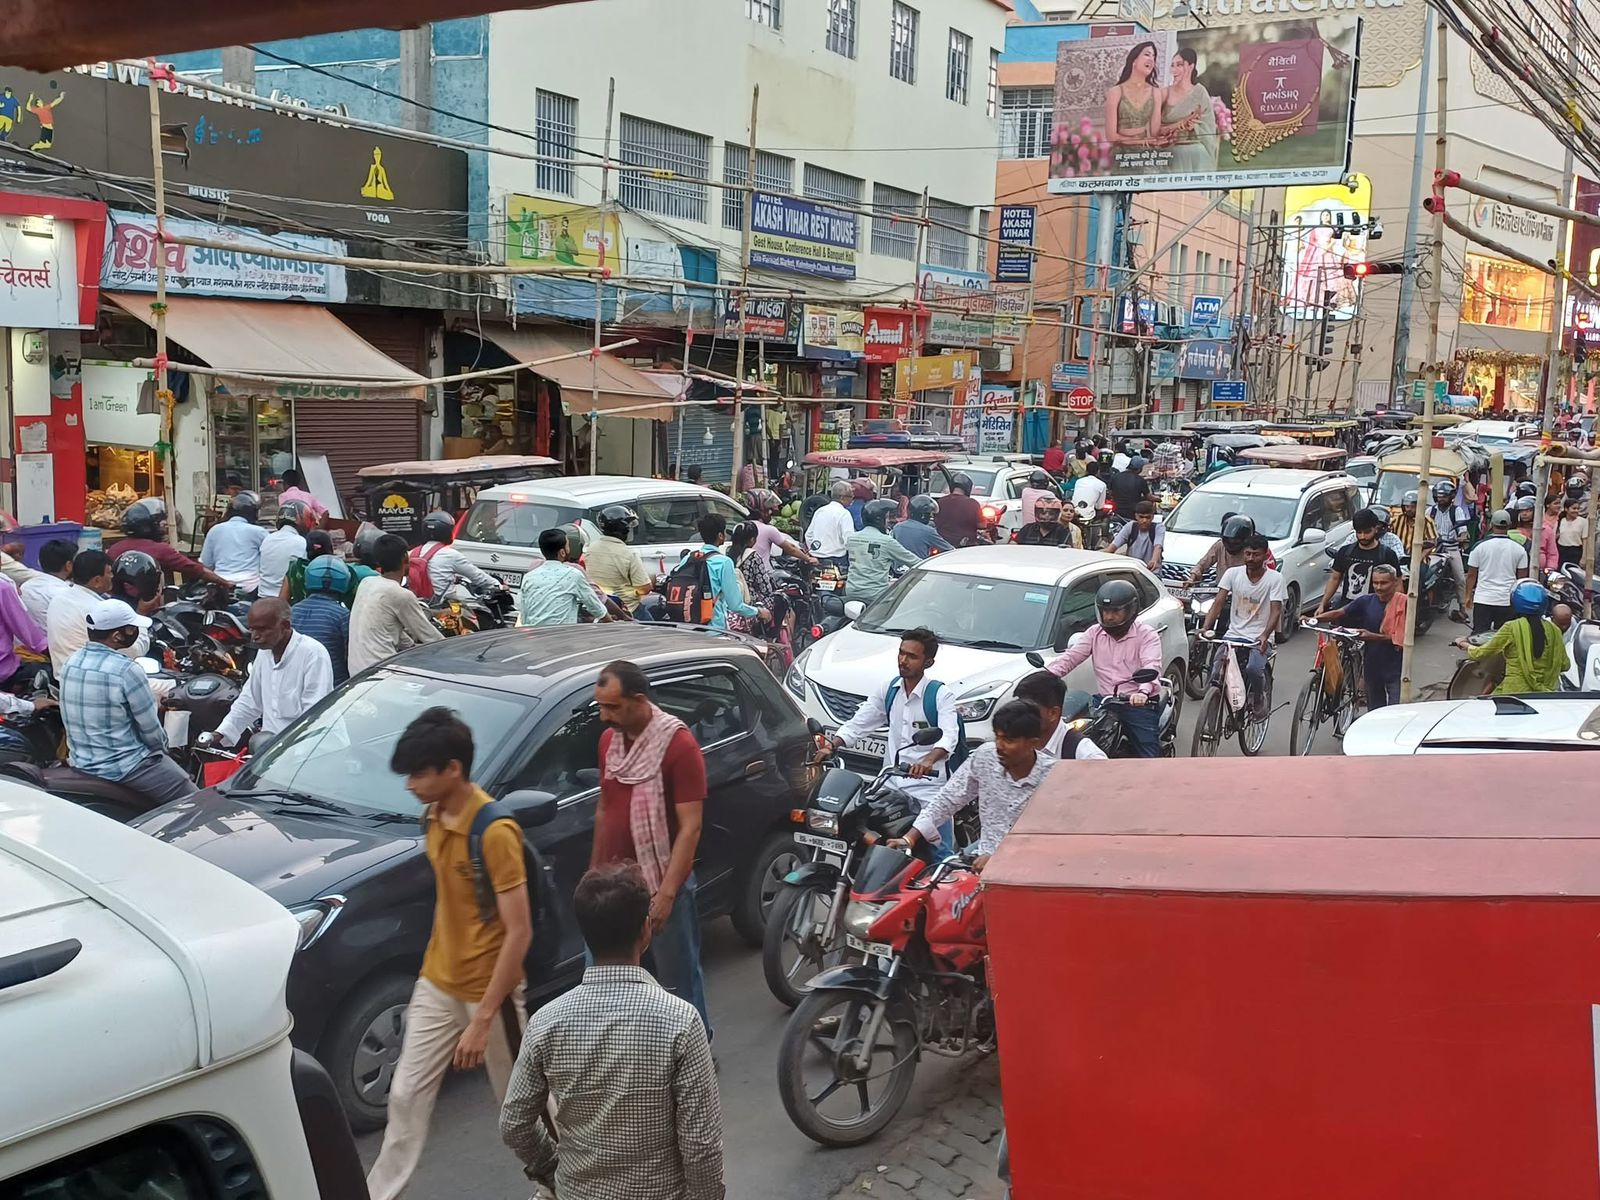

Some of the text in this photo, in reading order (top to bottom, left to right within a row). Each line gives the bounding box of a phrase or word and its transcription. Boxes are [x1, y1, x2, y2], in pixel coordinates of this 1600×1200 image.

[1261, 89, 1299, 103] TANISHQ
[1079, 179, 1123, 188] कलमबाग
[1125, 177, 1140, 187] रोड
[188, 185, 230, 202] MUSIC
[365, 211, 391, 224] YOGA
[1003, 209, 1032, 218] HOTEL
[754, 202, 783, 231] AKASH
[785, 208, 809, 236] VIHAR
[810, 213, 830, 239] REST
[830, 218, 854, 244] HOUSE
[1002, 219, 1032, 228] AKASH
[587, 232, 609, 245] forte
[1003, 228, 1030, 238] VIHAR
[1195, 302, 1219, 312] ATM
[866, 319, 904, 344] Amul
[94, 400, 104, 411] am
[105, 399, 128, 413] Green
[1070, 395, 1094, 406] STOP
[981, 416, 1012, 431] मेडिसिन
